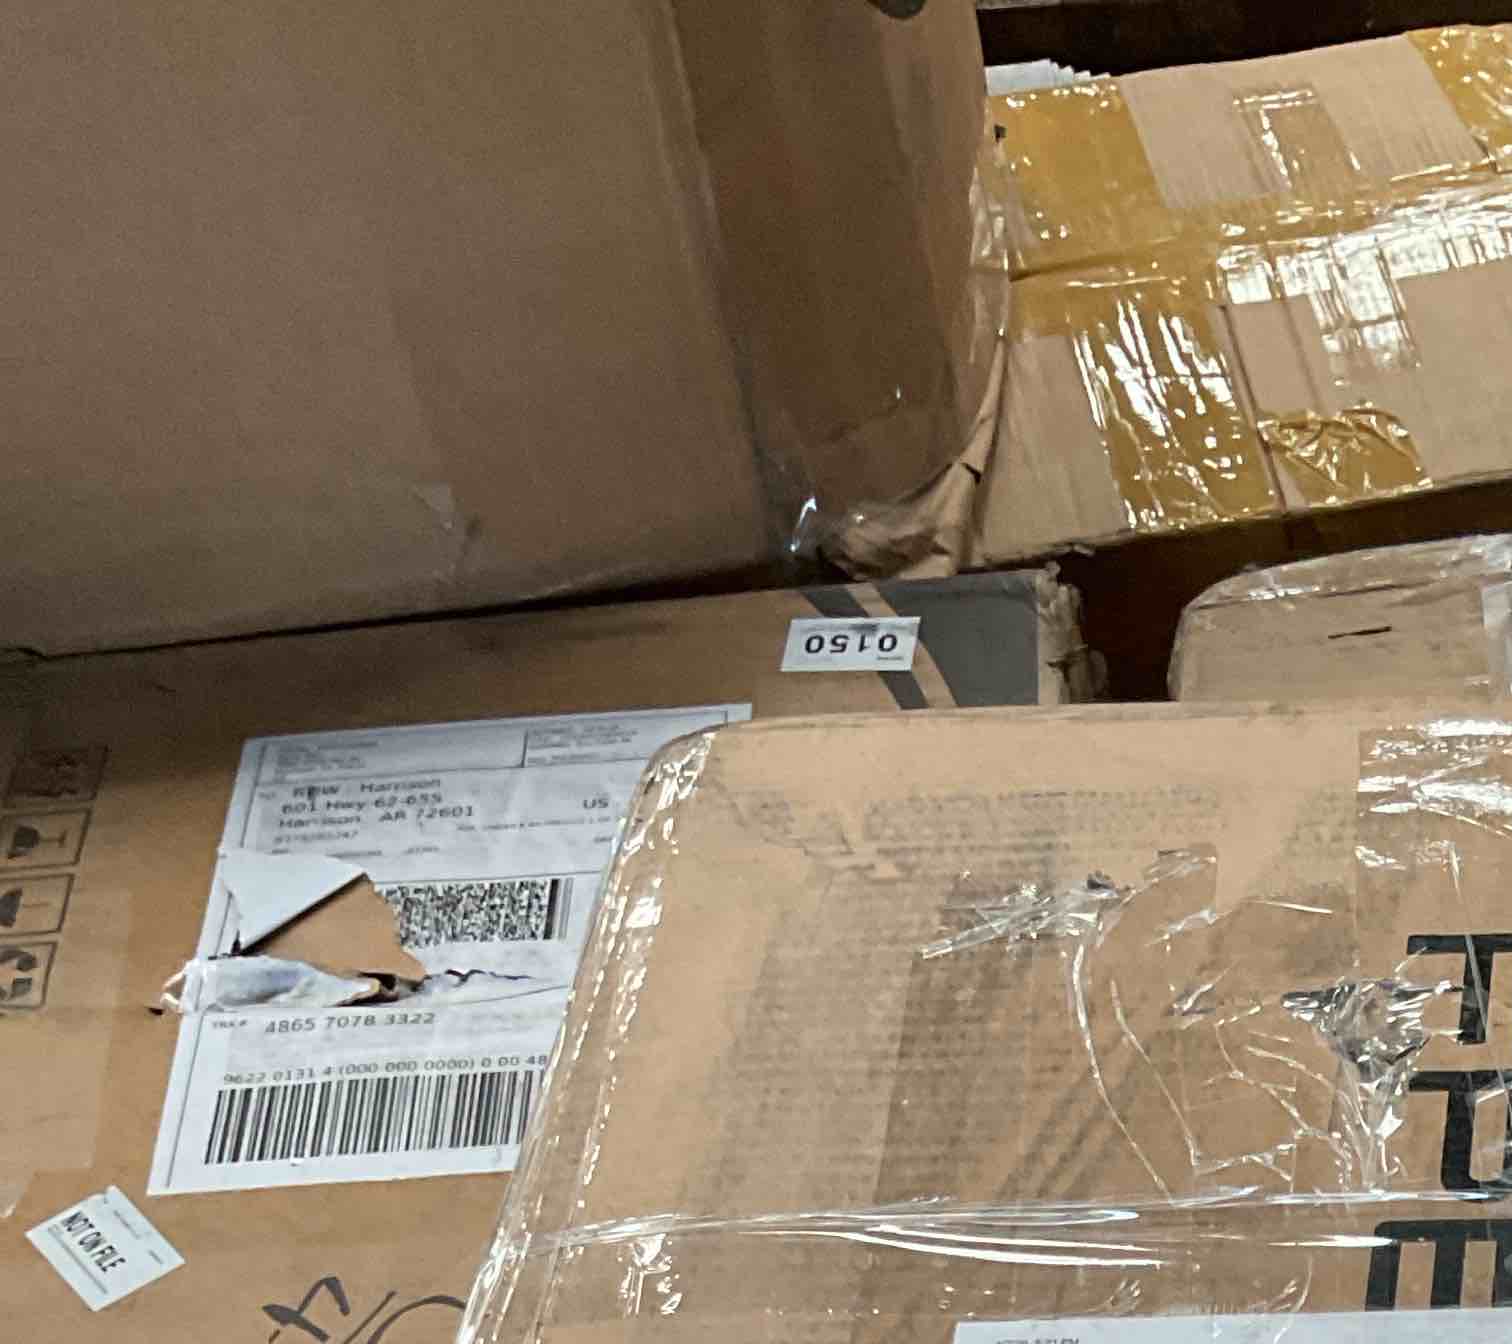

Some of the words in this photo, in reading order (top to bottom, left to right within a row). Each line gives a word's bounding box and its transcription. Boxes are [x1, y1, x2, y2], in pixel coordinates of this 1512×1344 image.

[805, 634, 898, 654] 0150
[281, 802, 318, 815] 601
[583, 798, 609, 810] US
[265, 1018, 316, 1036] 4865
[324, 1015, 377, 1031] 7078
[383, 1012, 435, 1027] 3322
[272, 1068, 316, 1082] 0131
